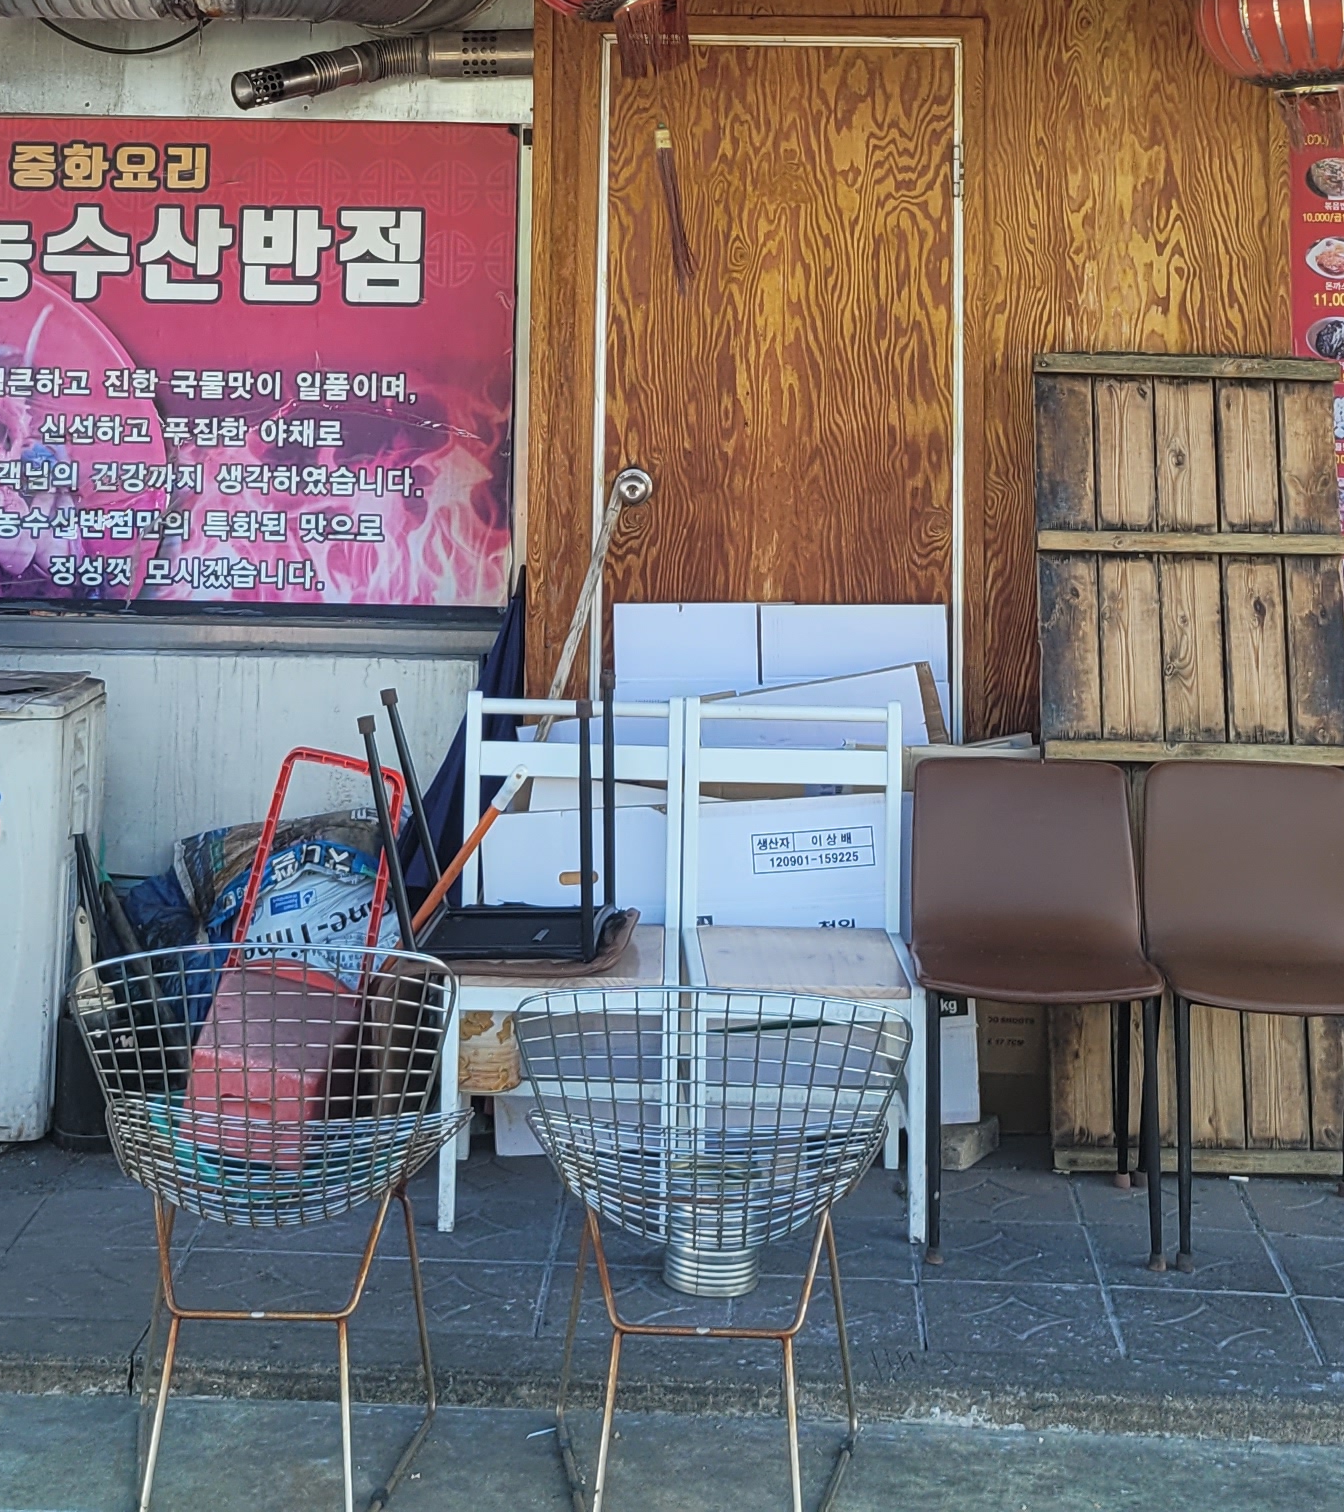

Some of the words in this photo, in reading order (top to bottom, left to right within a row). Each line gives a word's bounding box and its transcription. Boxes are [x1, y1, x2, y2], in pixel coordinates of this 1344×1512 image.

[10, 143, 211, 191] 중화요리
[105, 369, 158, 398] 진한
[170, 370, 282, 400] 국물맛이
[296, 372, 417, 403] 일품이며,
[40, 415, 151, 444] 신선하고
[163, 416, 248, 446] 푸짐한
[260, 418, 344, 447] 야채로
[91, 463, 204, 493] 건강까지
[216, 464, 424, 497] 생각하였습니다.
[204, 511, 286, 541] 특화된
[300, 513, 385, 542] 맛으로
[49, 557, 132, 586] 정성껏
[145, 558, 325, 590] 모시겠습니다.
[756, 837, 791, 851] 생산자
[769, 851, 859, 868] 120901-159225
[940, 998, 958, 1014] kg
